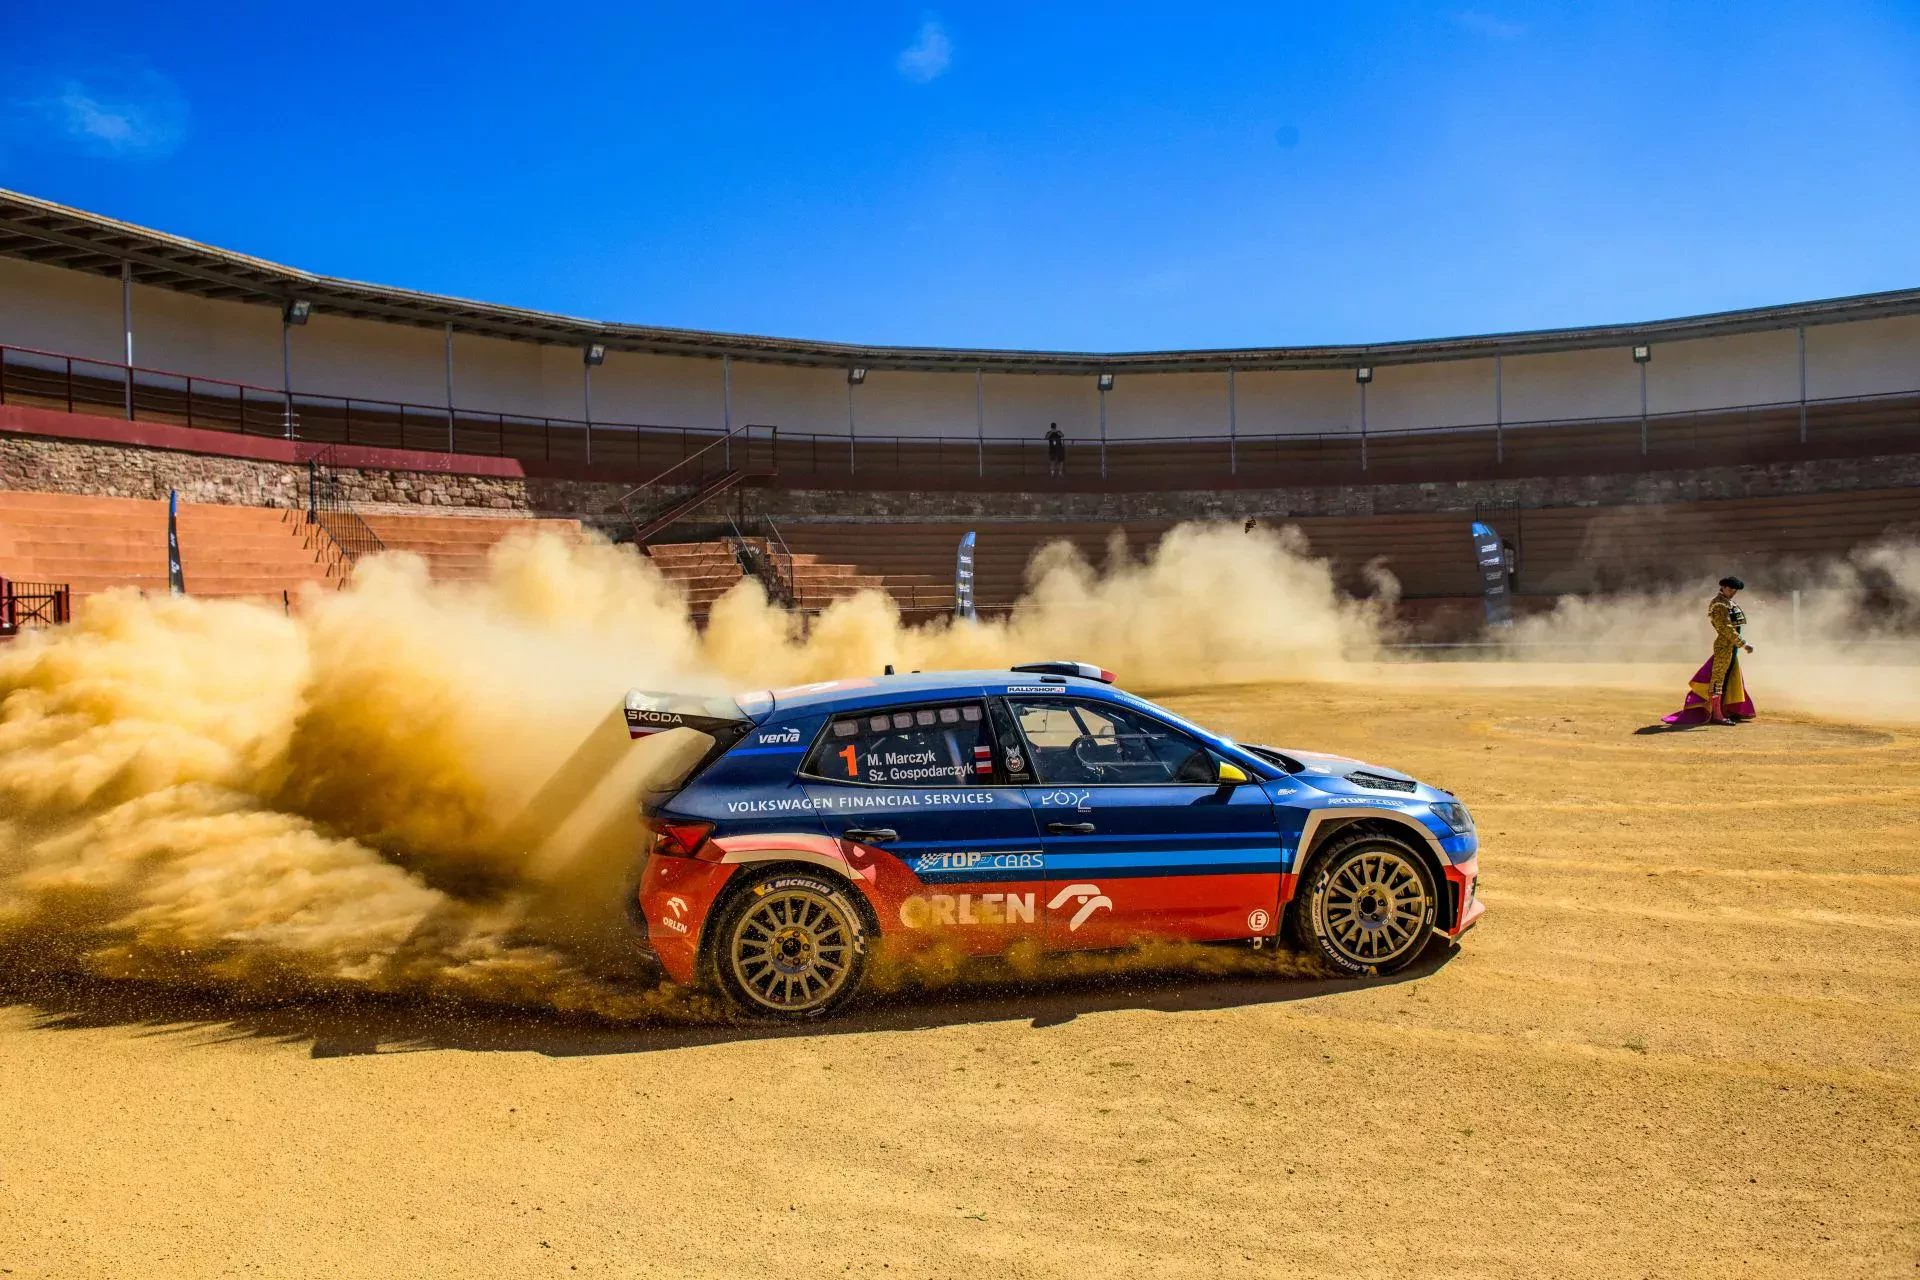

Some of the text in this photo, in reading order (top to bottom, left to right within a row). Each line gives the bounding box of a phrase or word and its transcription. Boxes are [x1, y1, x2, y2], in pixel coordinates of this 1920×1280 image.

[758, 732, 800, 744] verva
[838, 744, 859, 777] 1
[867, 749, 936, 767] M. Marczyk
[868, 762, 975, 782] Sz. Gospodarczyk
[727, 793, 994, 813] VOLKSWAGEN FINANCIAL SERVICES
[941, 852, 1044, 868] TOP CARS
[775, 878, 831, 894] MICHELIN
[900, 892, 1035, 929] ORLEN
[662, 916, 688, 934] ORLEN
